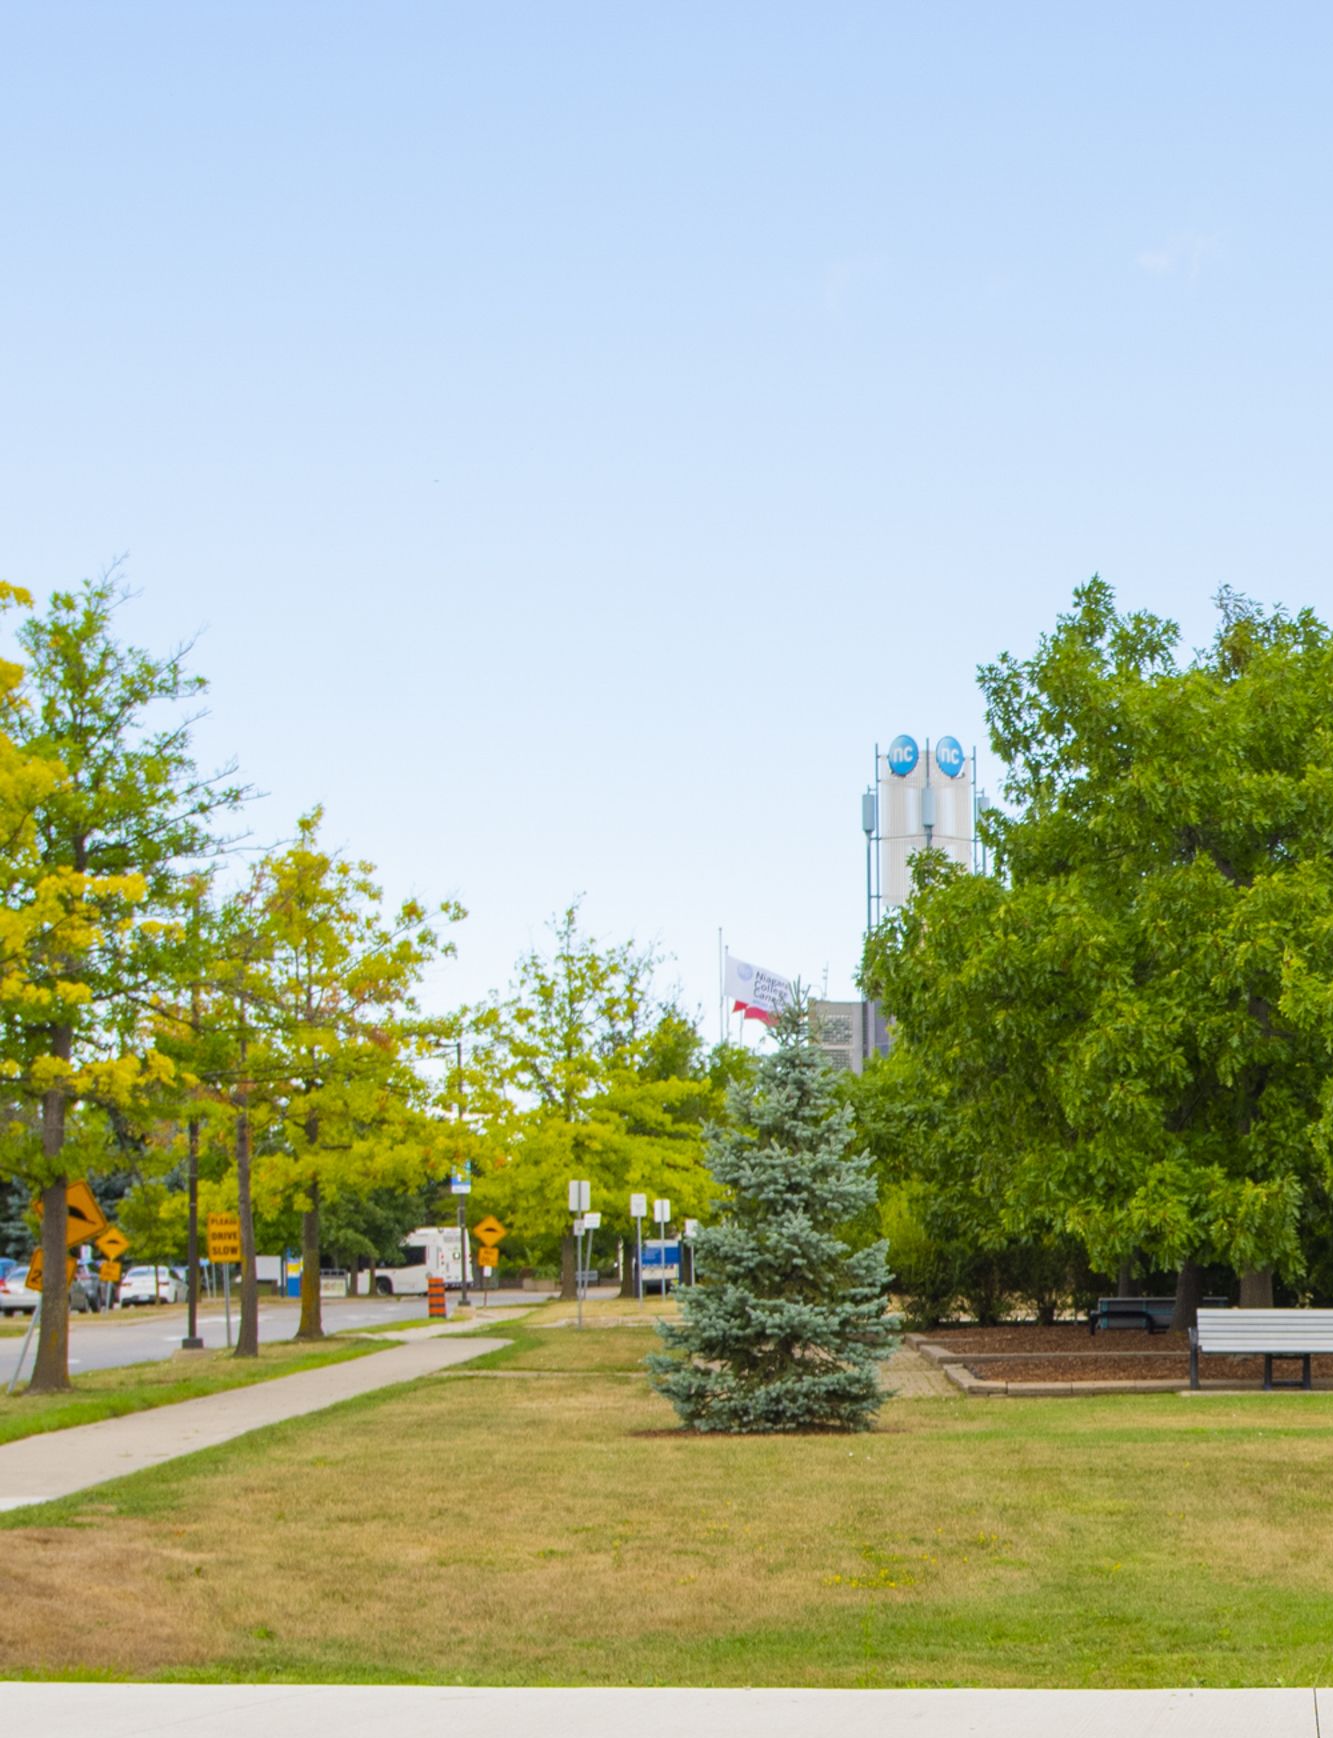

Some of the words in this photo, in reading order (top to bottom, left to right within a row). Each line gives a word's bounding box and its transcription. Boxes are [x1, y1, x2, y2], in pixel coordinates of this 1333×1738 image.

[893, 746, 913, 762] nc
[941, 748, 959, 765] nc
[756, 971, 788, 989] Niagara
[212, 1232, 237, 1240] DRIVE
[212, 1246, 238, 1256] SLOW
